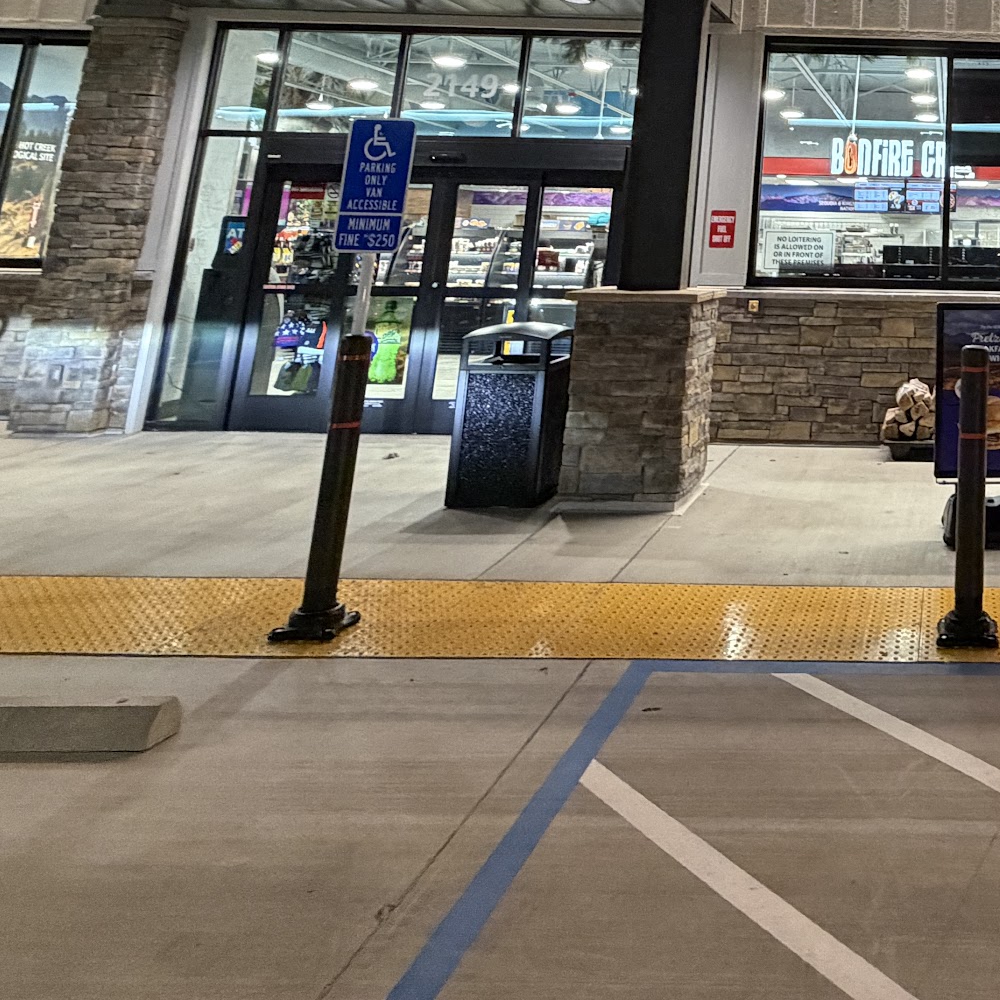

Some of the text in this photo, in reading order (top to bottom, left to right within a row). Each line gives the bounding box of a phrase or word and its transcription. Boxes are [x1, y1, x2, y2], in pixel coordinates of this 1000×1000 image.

[423, 72, 498, 99] 2149
[830, 137, 915, 177] BONFIRE
[358, 161, 398, 174] PARKING
[364, 174, 388, 186] ONLY
[365, 186, 384, 198] VAN
[346, 199, 398, 211] ACCESSIBLE
[347, 218, 391, 231] MINIMUM
[226, 228, 246, 239] AT
[338, 233, 396, 248] FINE $250
[772, 258, 792, 266] THESE
